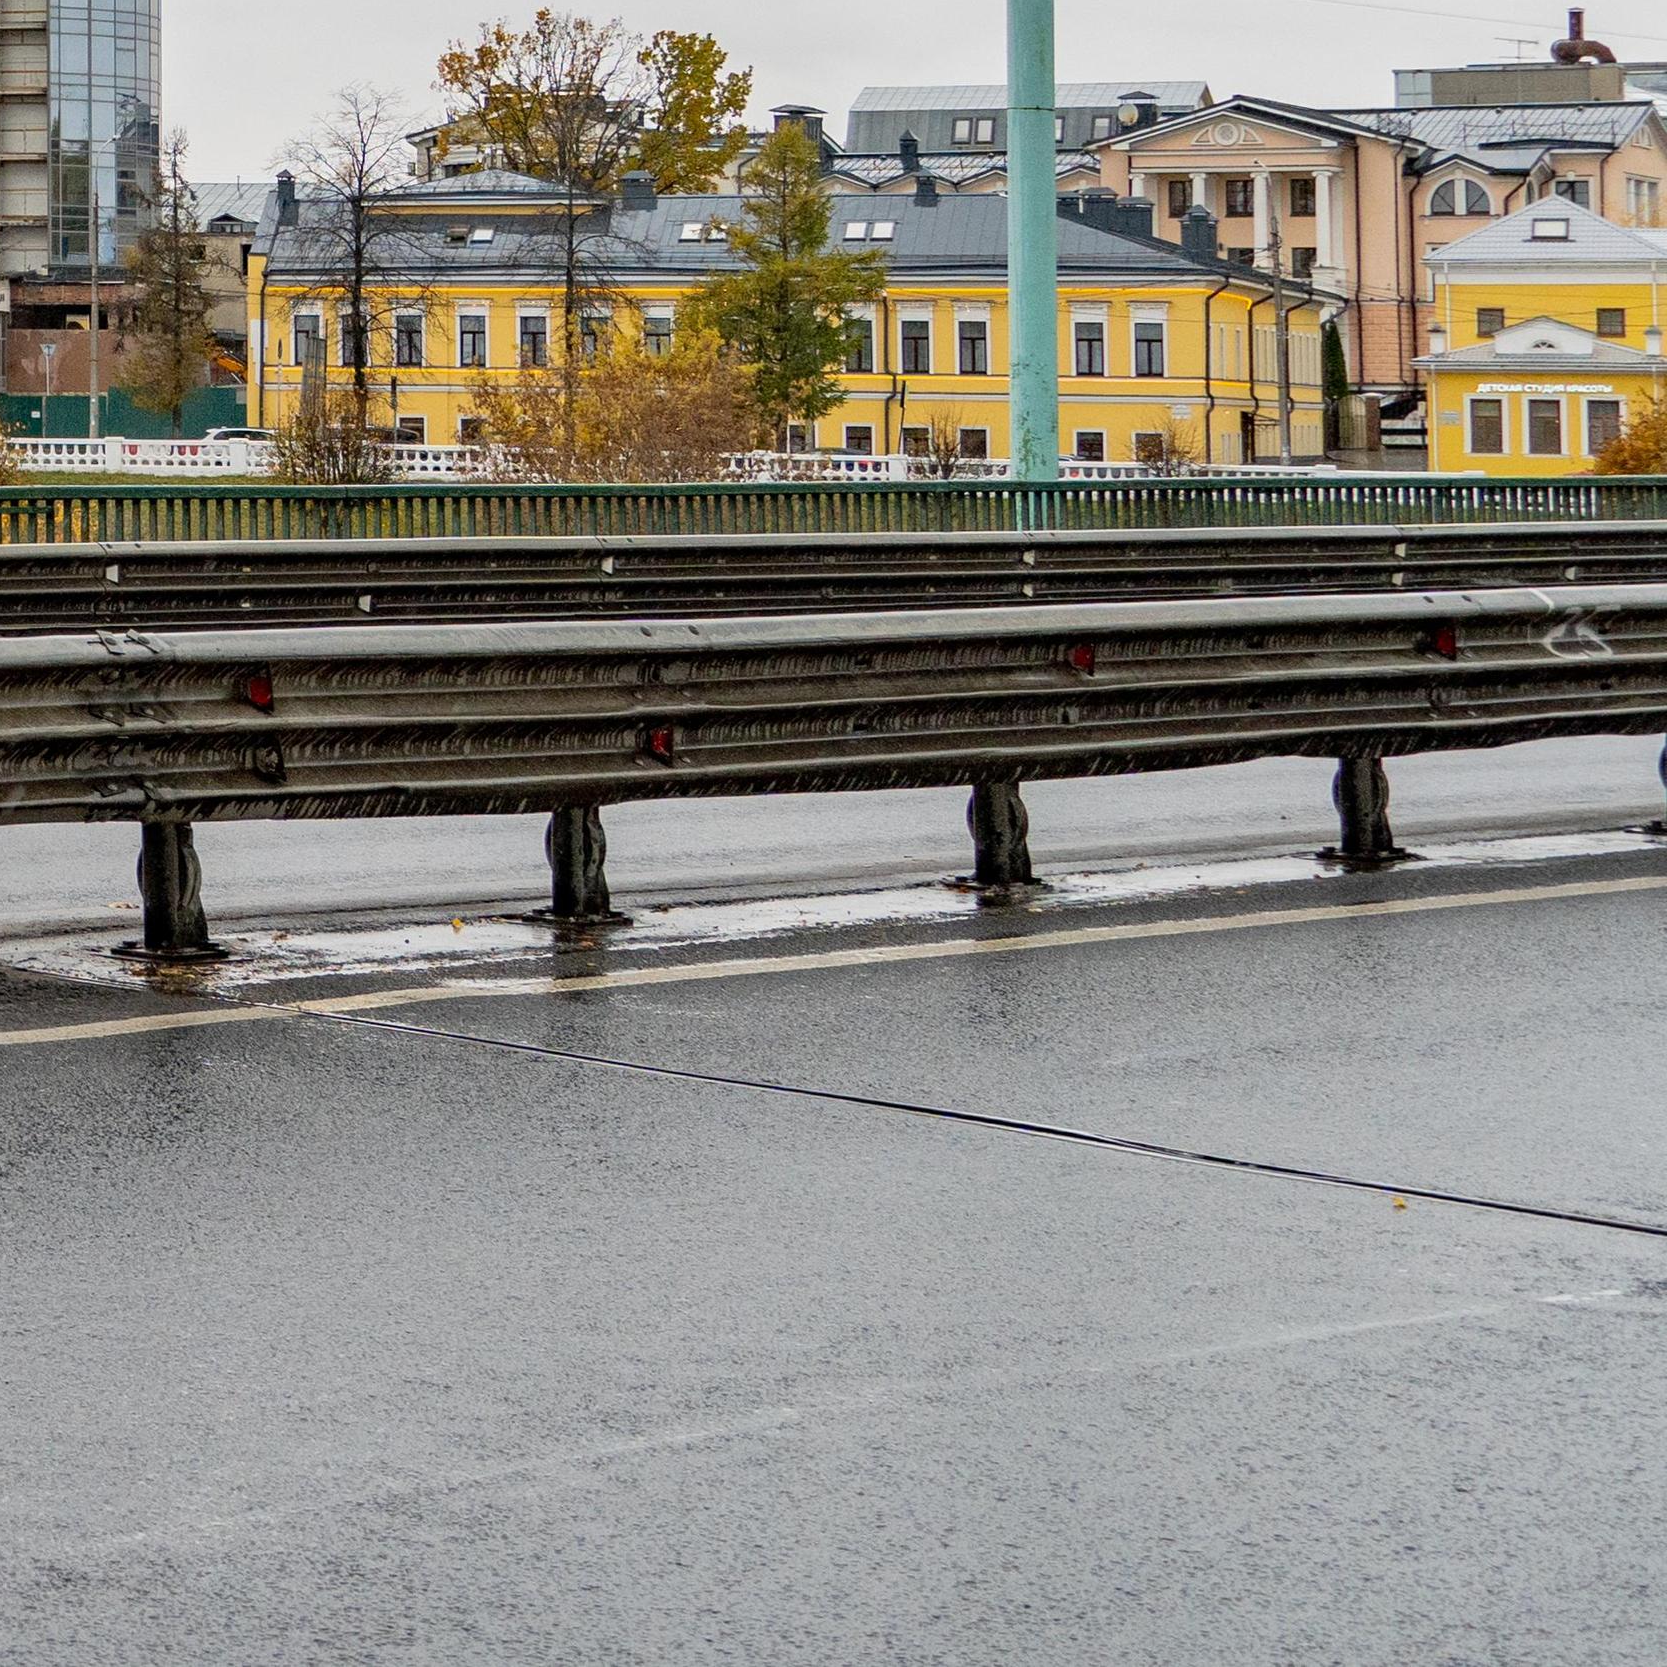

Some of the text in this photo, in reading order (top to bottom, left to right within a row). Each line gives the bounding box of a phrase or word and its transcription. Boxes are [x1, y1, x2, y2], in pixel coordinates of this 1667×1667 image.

[1477, 383, 1613, 394] ДЕТСКАЯ СТУДИЯ КРАСОТЫ
